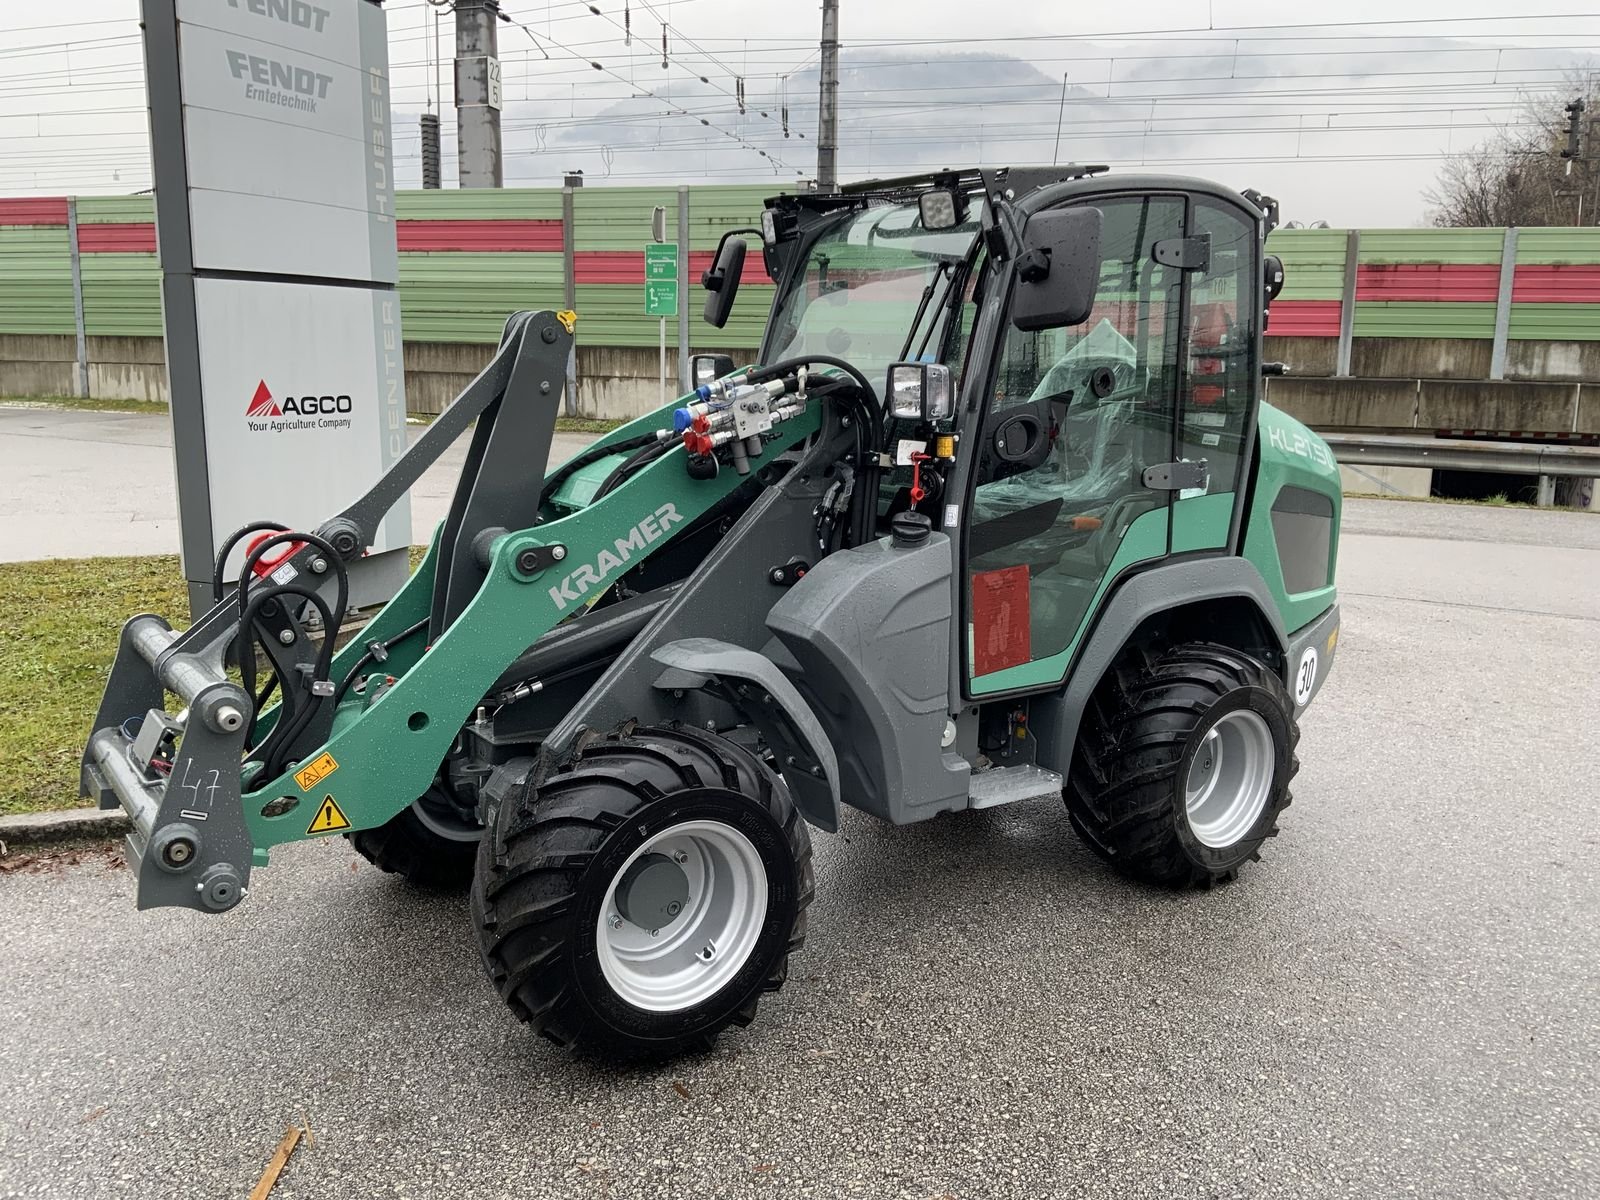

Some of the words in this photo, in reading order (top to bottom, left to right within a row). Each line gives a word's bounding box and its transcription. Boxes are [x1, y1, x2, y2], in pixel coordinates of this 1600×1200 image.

[225, 49, 333, 99] FENDT
[490, 62, 500, 83] 22
[245, 83, 317, 113] Erntetechnik
[493, 86, 499, 104] 5
[370, 66, 388, 223] HUBER
[382, 300, 401, 458] CENTER
[248, 421, 268, 432] Your
[270, 420, 316, 432] Agriculture
[318, 418, 352, 430] Company
[281, 395, 352, 416] AGCO
[548, 502, 684, 611] KRAMER
[1299, 657, 1315, 697] 30
[182, 757, 221, 807] 47
